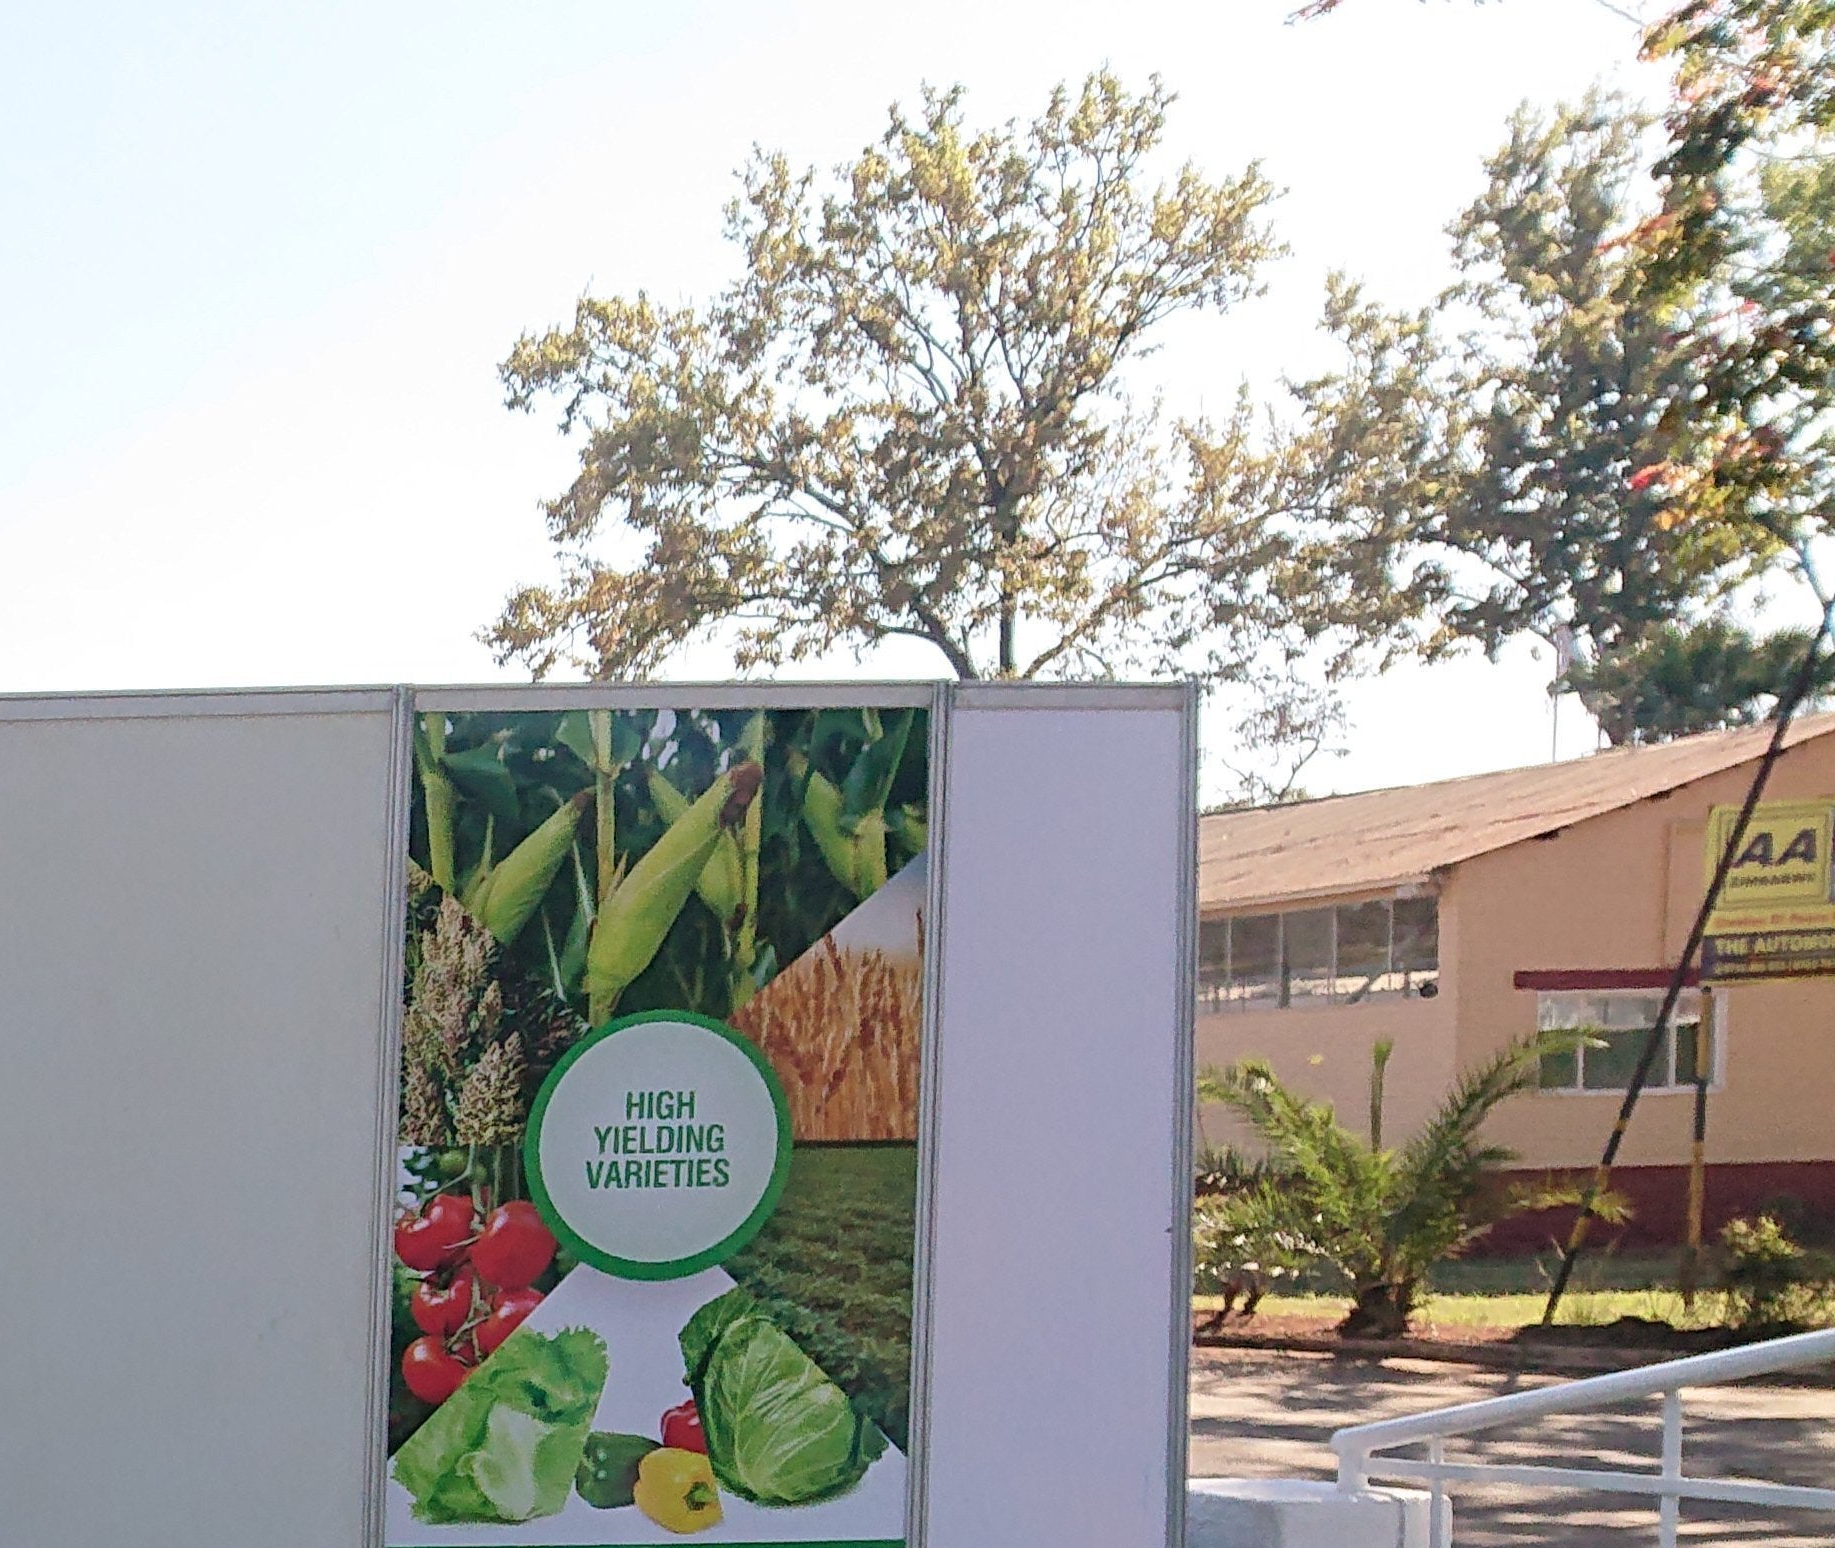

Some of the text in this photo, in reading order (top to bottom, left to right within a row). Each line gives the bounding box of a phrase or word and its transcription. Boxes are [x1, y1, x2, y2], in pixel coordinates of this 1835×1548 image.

[1731, 828, 1817, 868] AA
[625, 1090, 696, 1120] HIGH
[594, 1124, 724, 1154] YIELDING
[586, 1159, 730, 1189] VARIETIES
